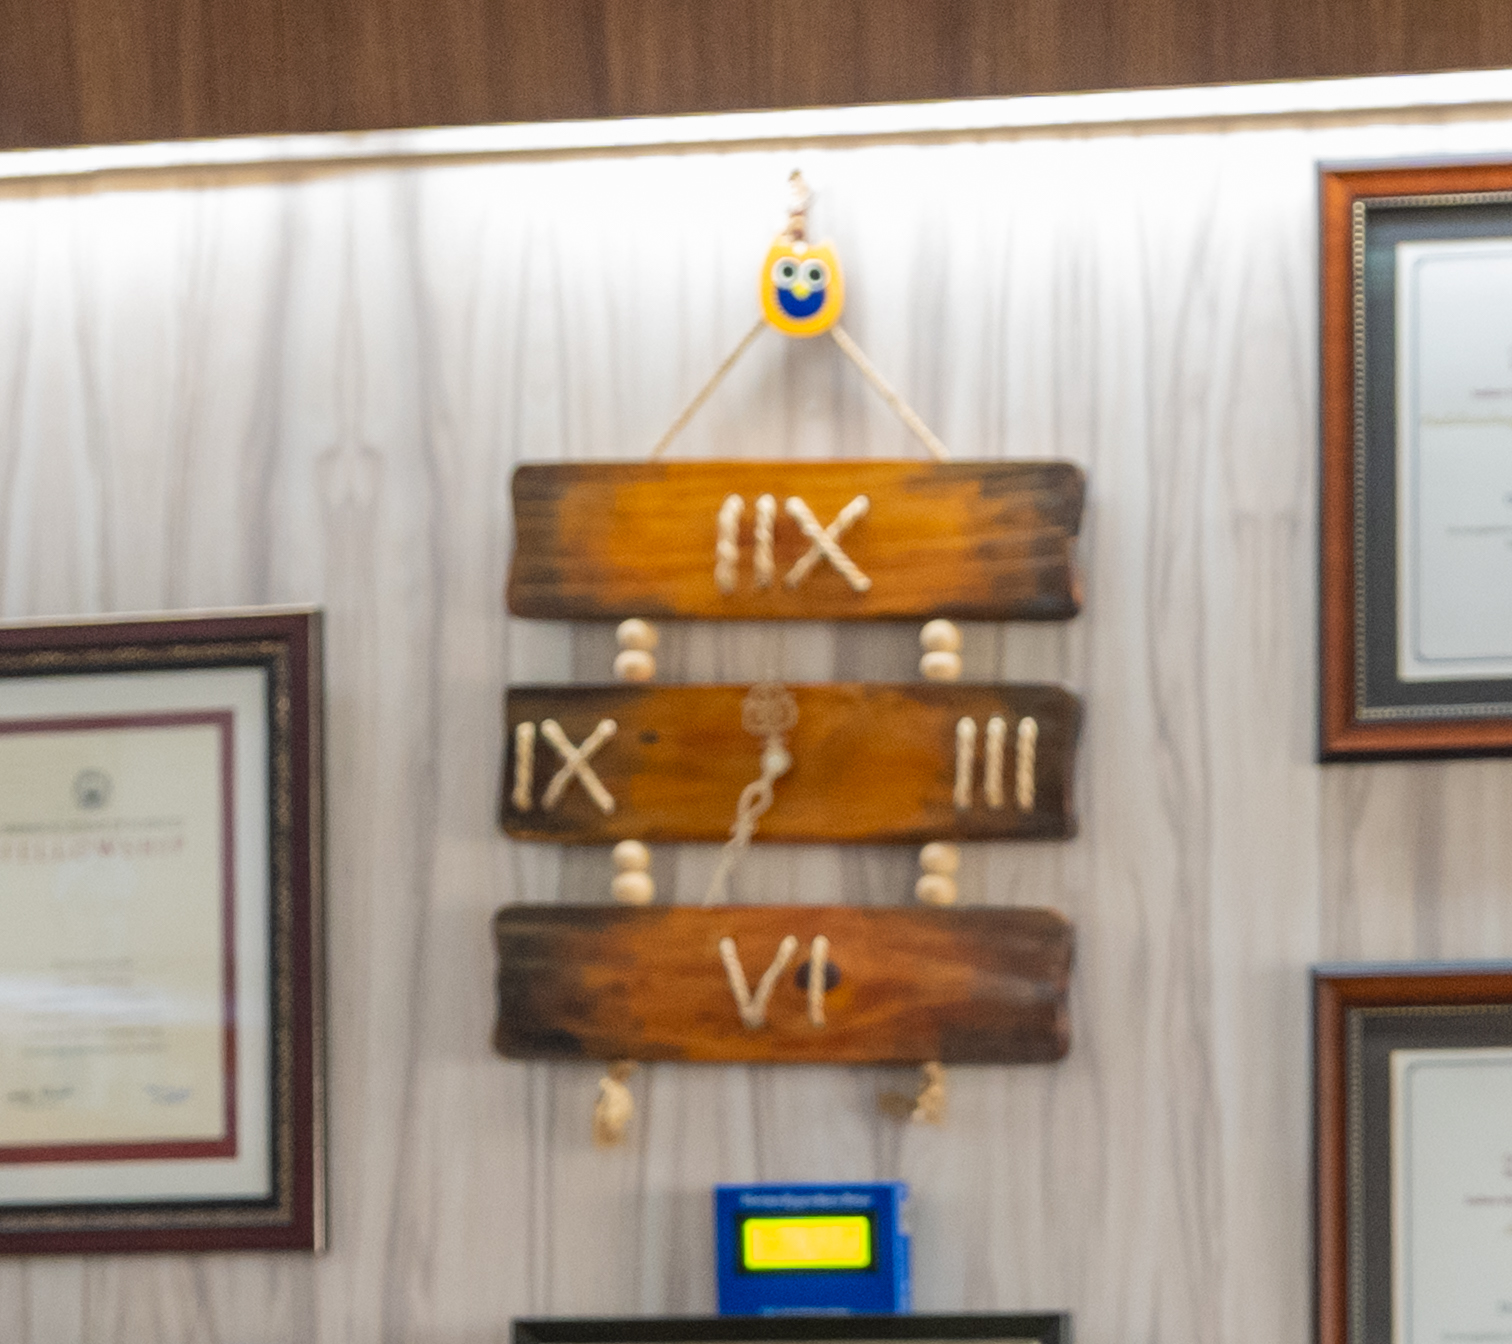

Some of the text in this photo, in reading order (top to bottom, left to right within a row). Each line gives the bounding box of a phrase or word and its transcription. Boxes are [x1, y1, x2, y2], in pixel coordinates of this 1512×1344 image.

[513, 719, 616, 812] IX
[956, 716, 1038, 810] III
[719, 935, 829, 1029] VI
